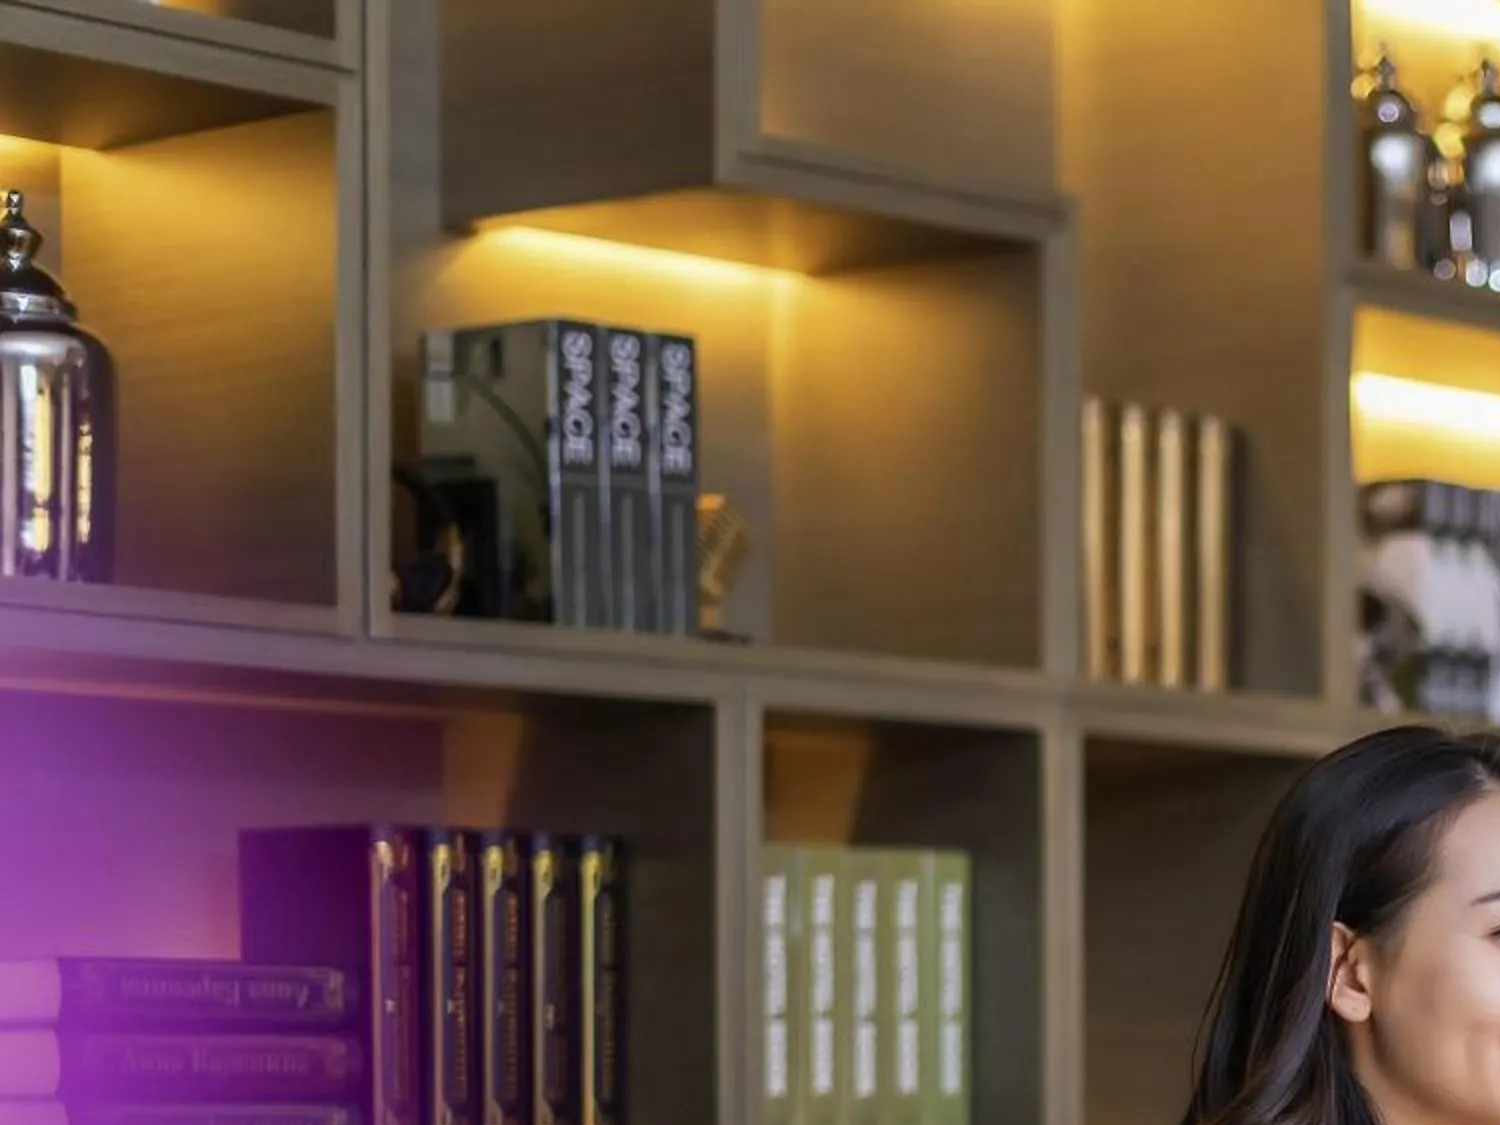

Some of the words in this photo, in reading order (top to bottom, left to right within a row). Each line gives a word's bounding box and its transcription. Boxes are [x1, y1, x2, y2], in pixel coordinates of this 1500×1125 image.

[562, 330, 593, 465] SPACE
[610, 334, 641, 467] SPACE
[661, 343, 692, 474] SPACE
